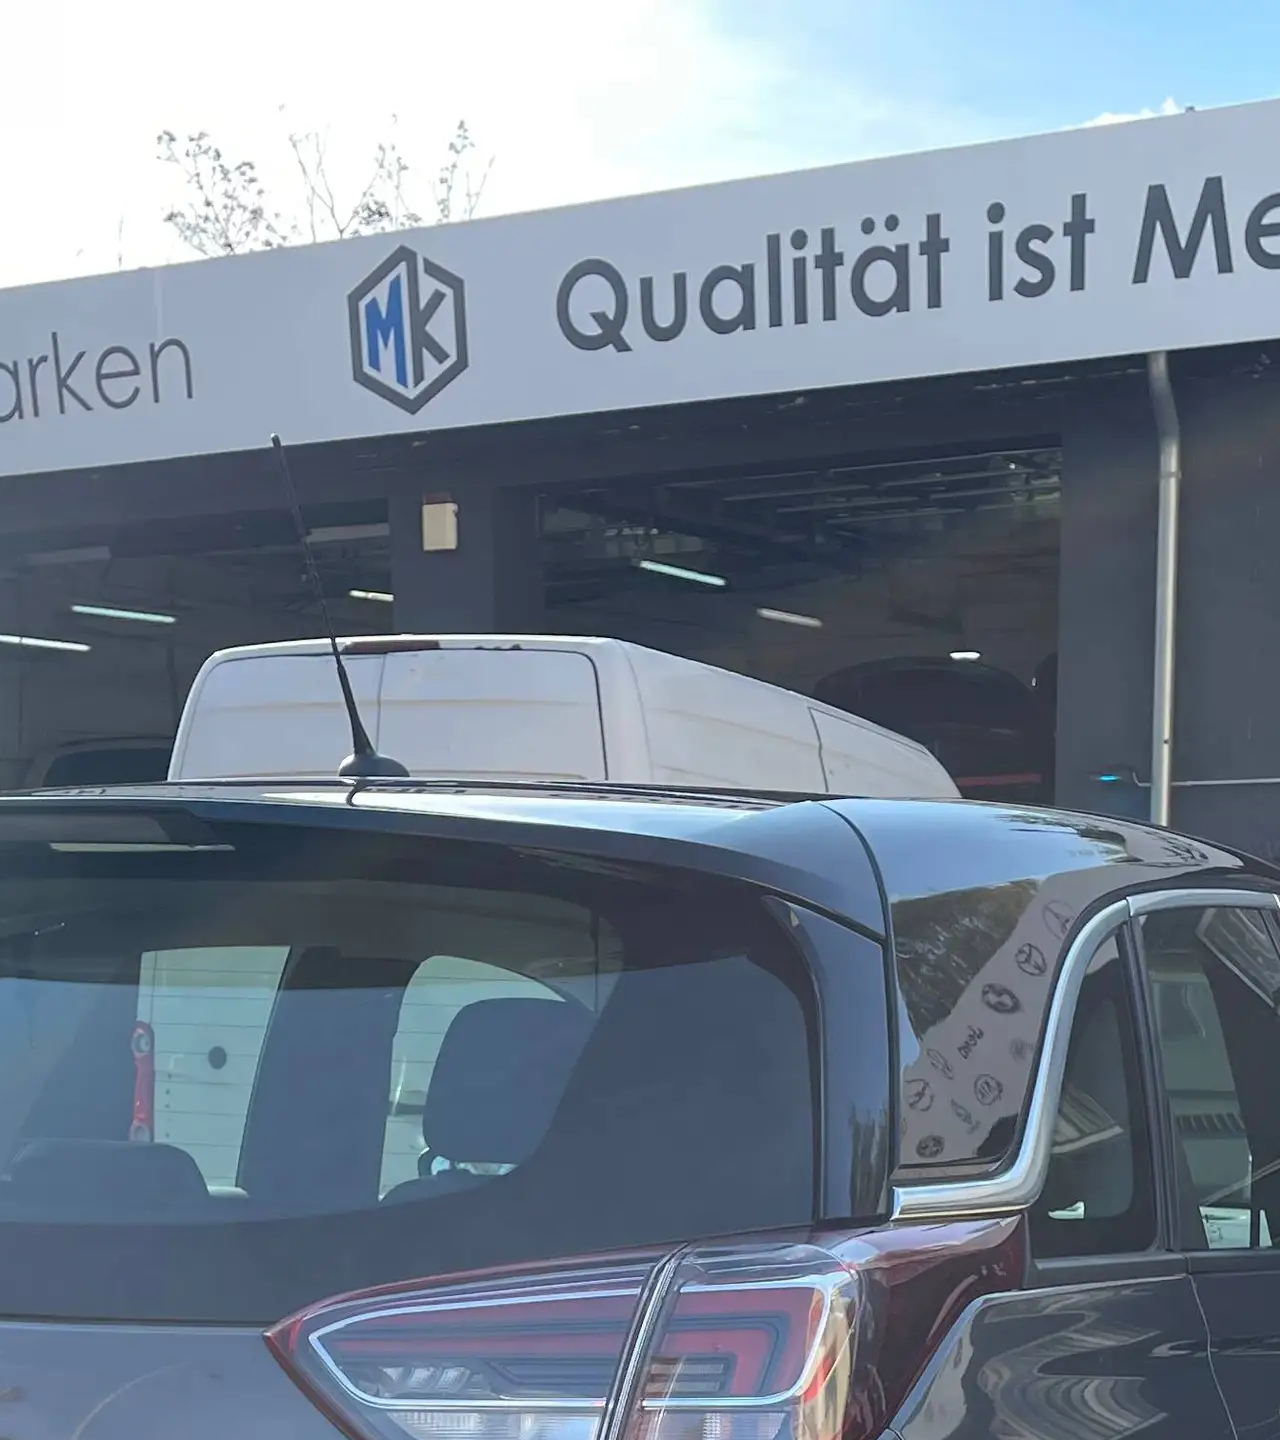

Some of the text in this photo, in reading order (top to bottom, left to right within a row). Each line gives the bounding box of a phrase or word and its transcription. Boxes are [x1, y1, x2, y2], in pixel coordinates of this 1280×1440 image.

[363, 248, 452, 390] MK
[556, 213, 950, 352] Qualität
[986, 193, 1095, 301] ist
